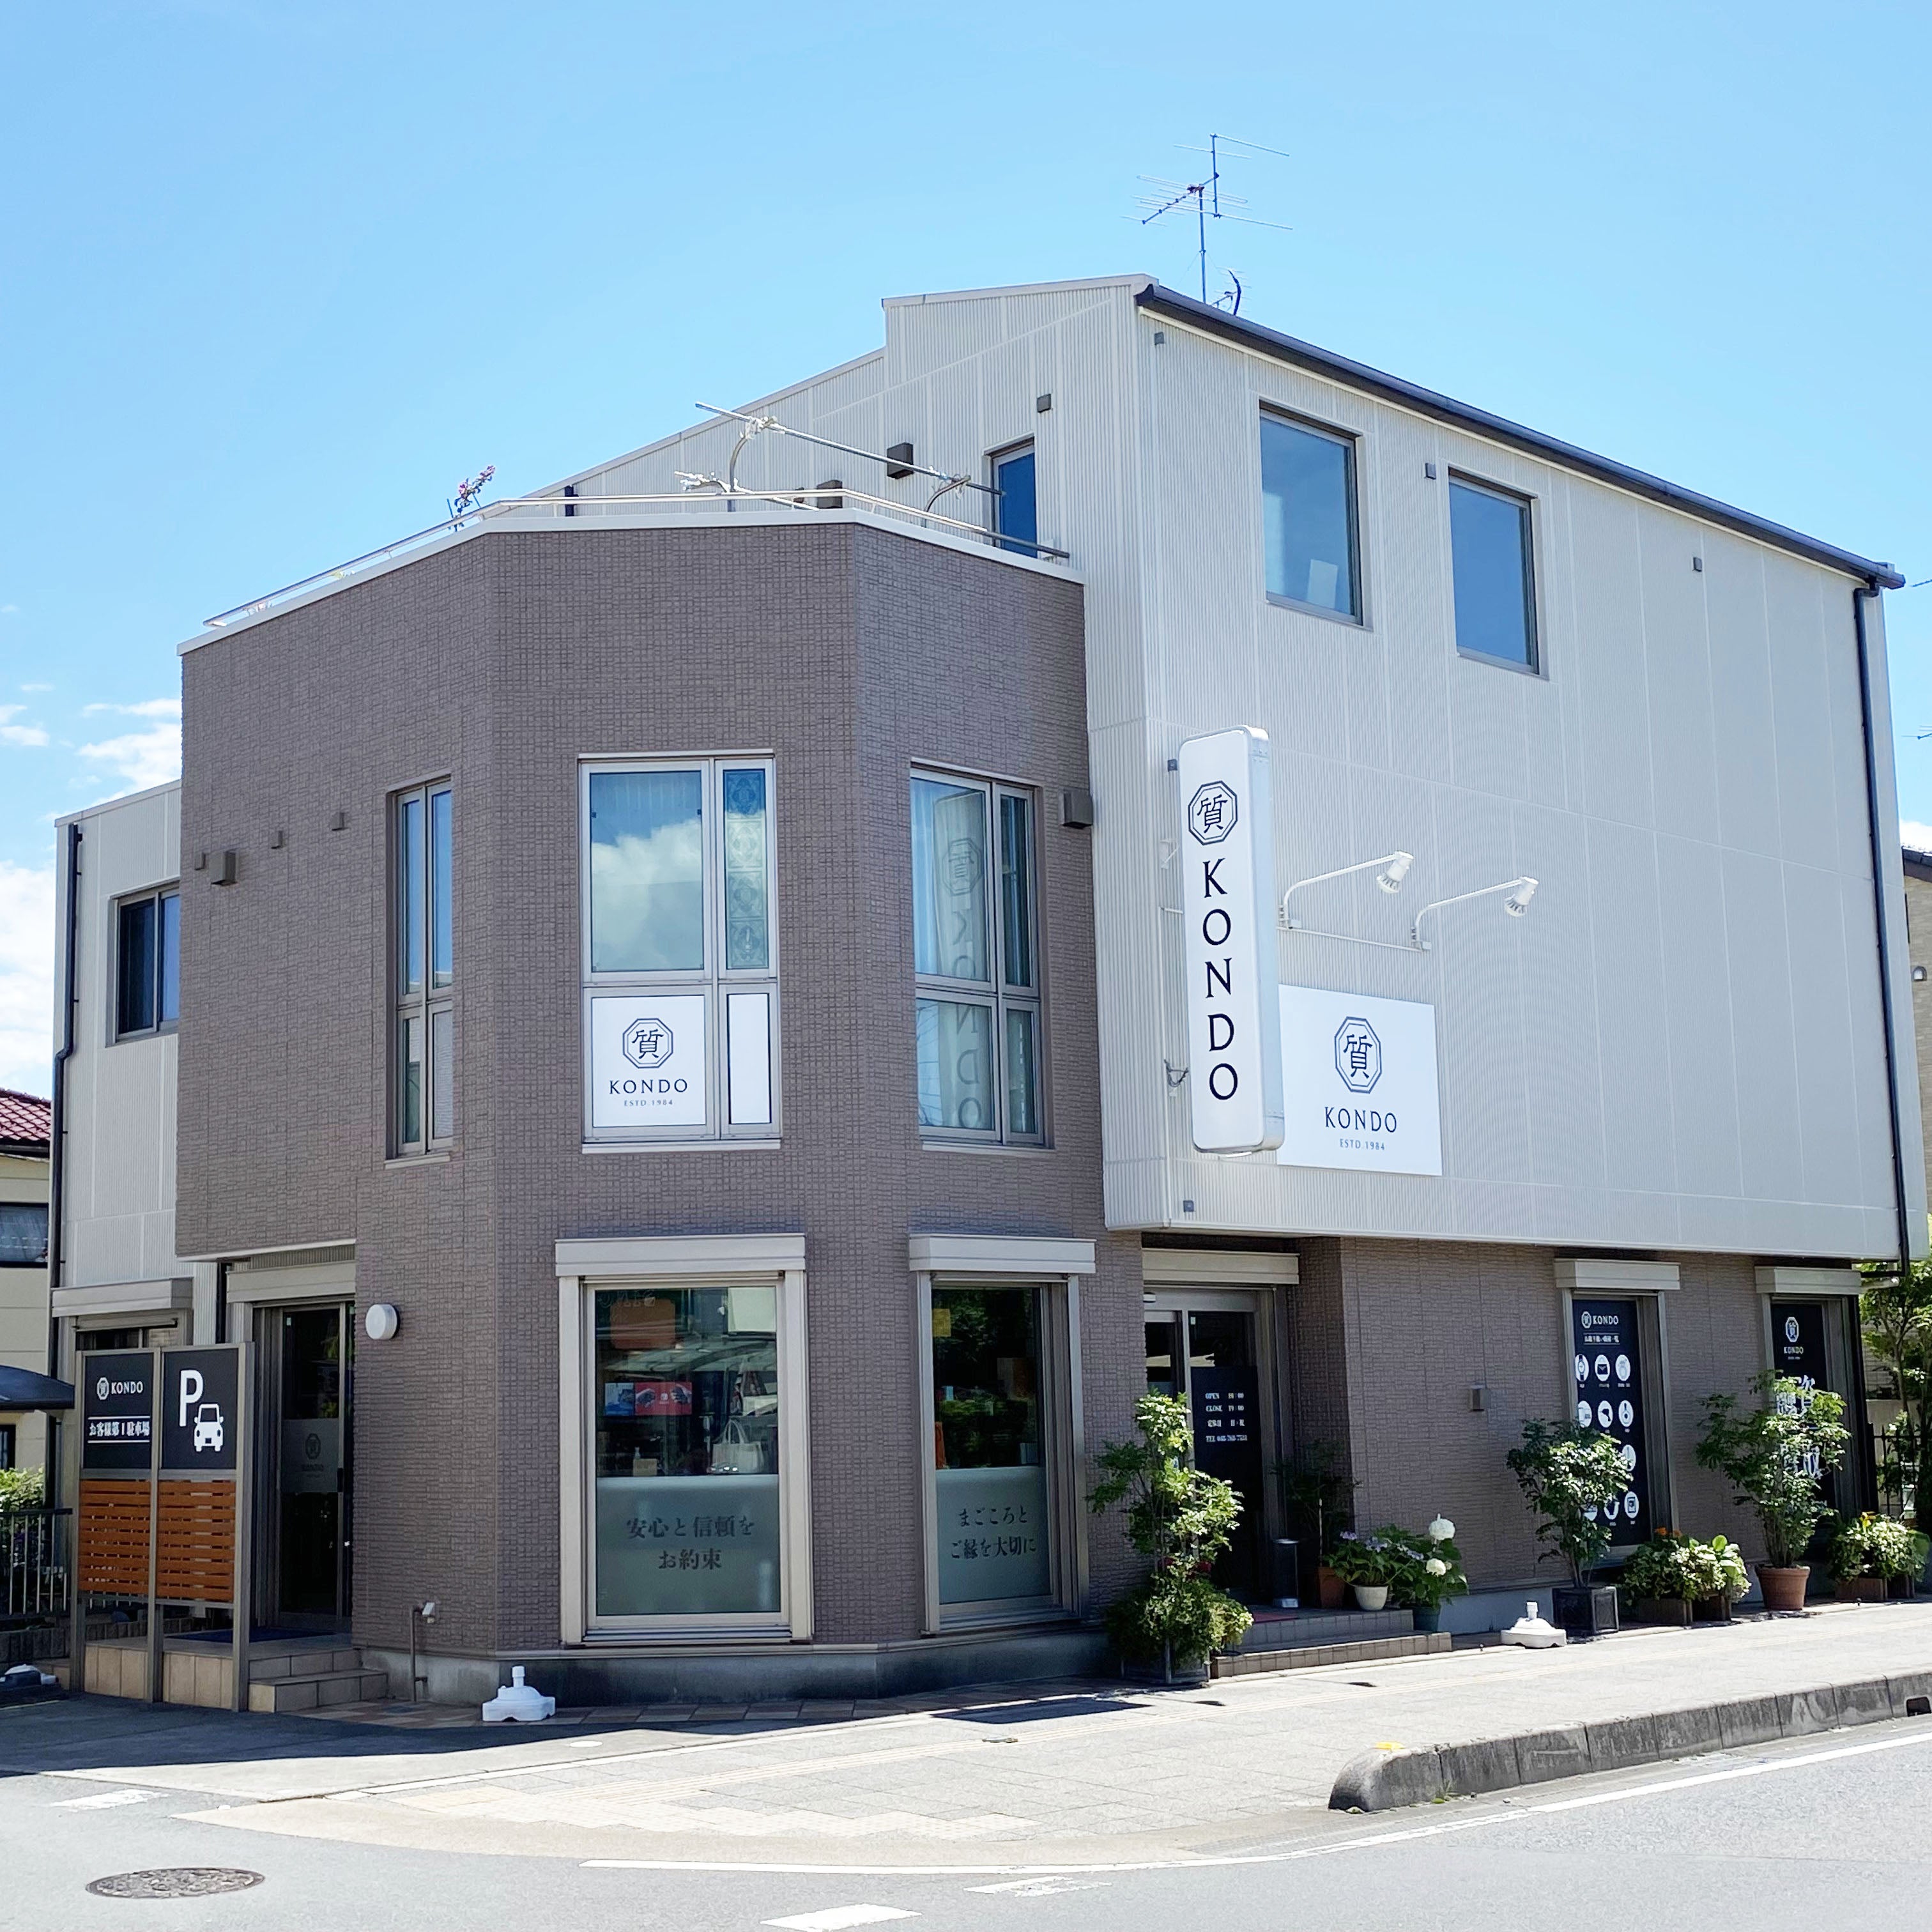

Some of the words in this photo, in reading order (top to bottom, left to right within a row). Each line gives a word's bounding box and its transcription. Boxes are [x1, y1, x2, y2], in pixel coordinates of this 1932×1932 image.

[1197, 794, 1228, 833] 質
[1202, 857, 1238, 1100] KONDO
[632, 1029, 664, 1059] 質
[1343, 1034, 1373, 1078] 質
[610, 1078, 687, 1094] KONDO
[1324, 1107, 1397, 1133] KONDO
[1593, 1315, 1619, 1324] KONDO
[111, 1381, 144, 1394] KONDO
[180, 1369, 204, 1427] P
[626, 1515, 755, 1539] 安心と信頼を
[958, 1505, 1027, 1527] まごころと
[658, 1547, 722, 1570] お約束
[951, 1536, 1036, 1560] ご縁を大切に
